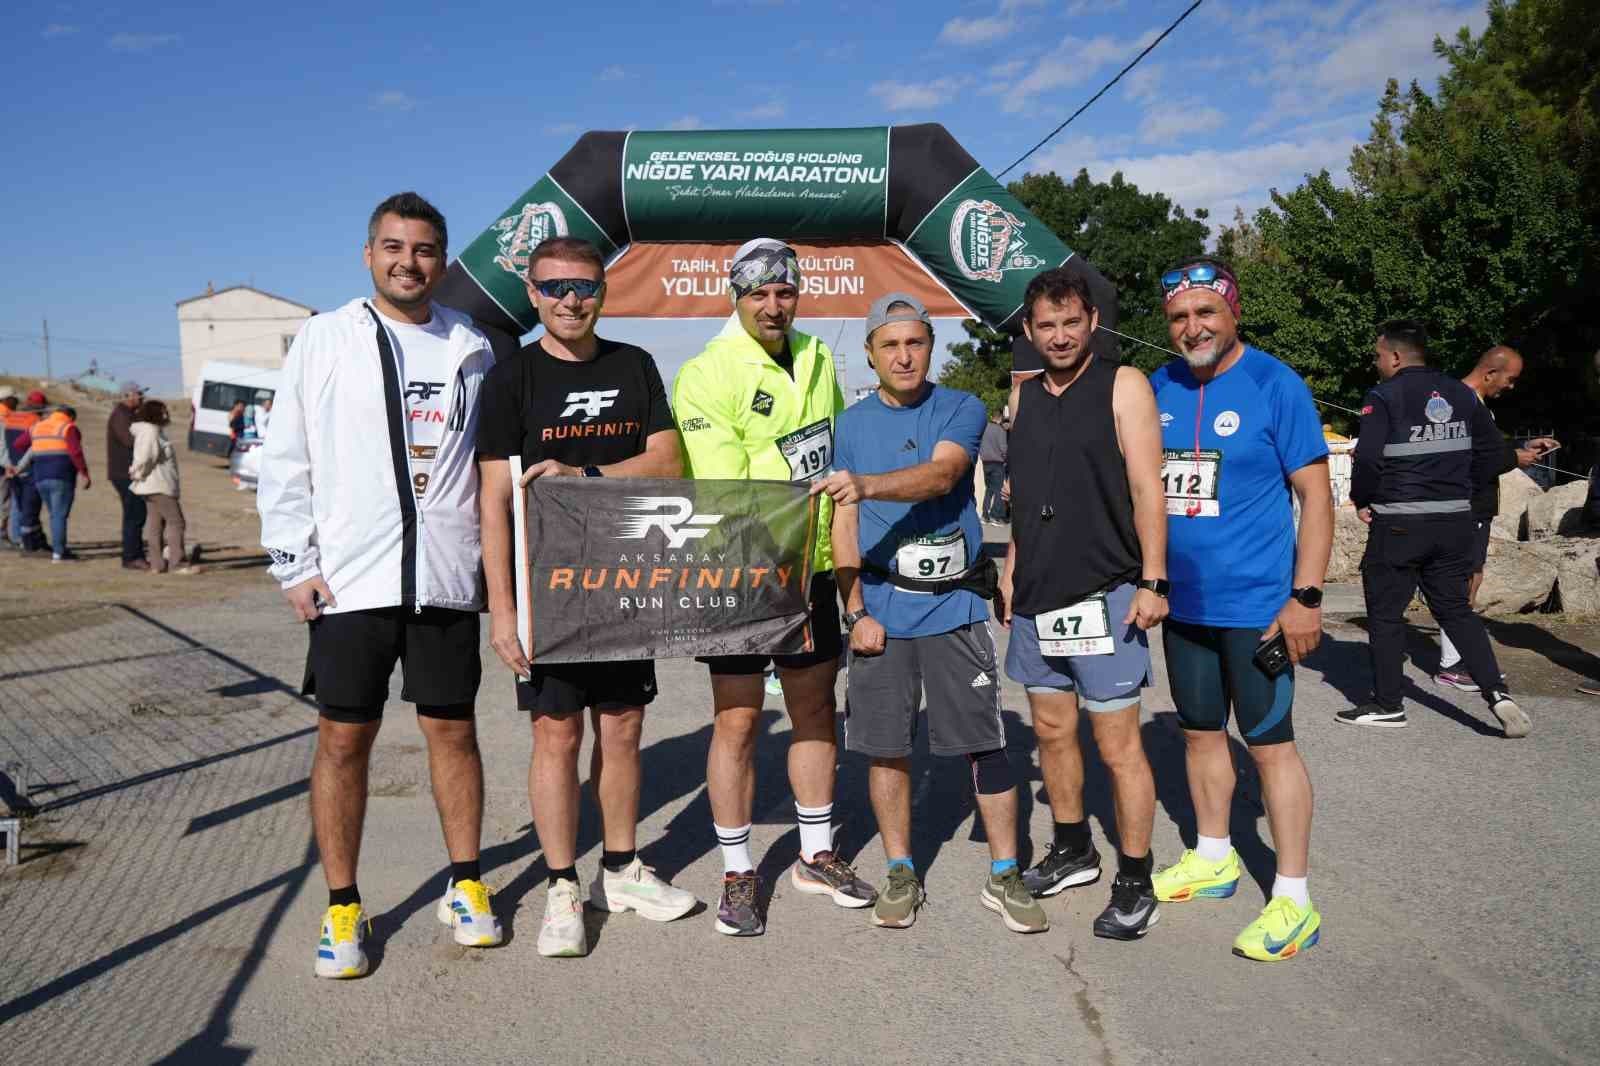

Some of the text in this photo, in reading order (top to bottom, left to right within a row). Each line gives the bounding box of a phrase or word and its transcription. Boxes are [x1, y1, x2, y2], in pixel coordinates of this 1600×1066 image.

[650, 150, 863, 165] GELENEKSEL DOĞUŞ HOLDİNG
[626, 160, 886, 184] NİĞDE YARI MARATONU
[977, 212, 992, 268] NİĞDE
[671, 257, 719, 274] TARİH,
[799, 276, 864, 299] OŞUN!
[542, 421, 641, 441] RUNFINITY
[1409, 420, 1468, 442] ZABITA
[800, 445, 828, 474] 197
[1161, 473, 1202, 494] 112
[619, 553, 727, 563] AKSARAY
[918, 555, 952, 577] 97
[550, 565, 794, 592] RUNFINITY
[619, 596, 738, 610] RUN CLUB
[1052, 615, 1083, 636] 47
